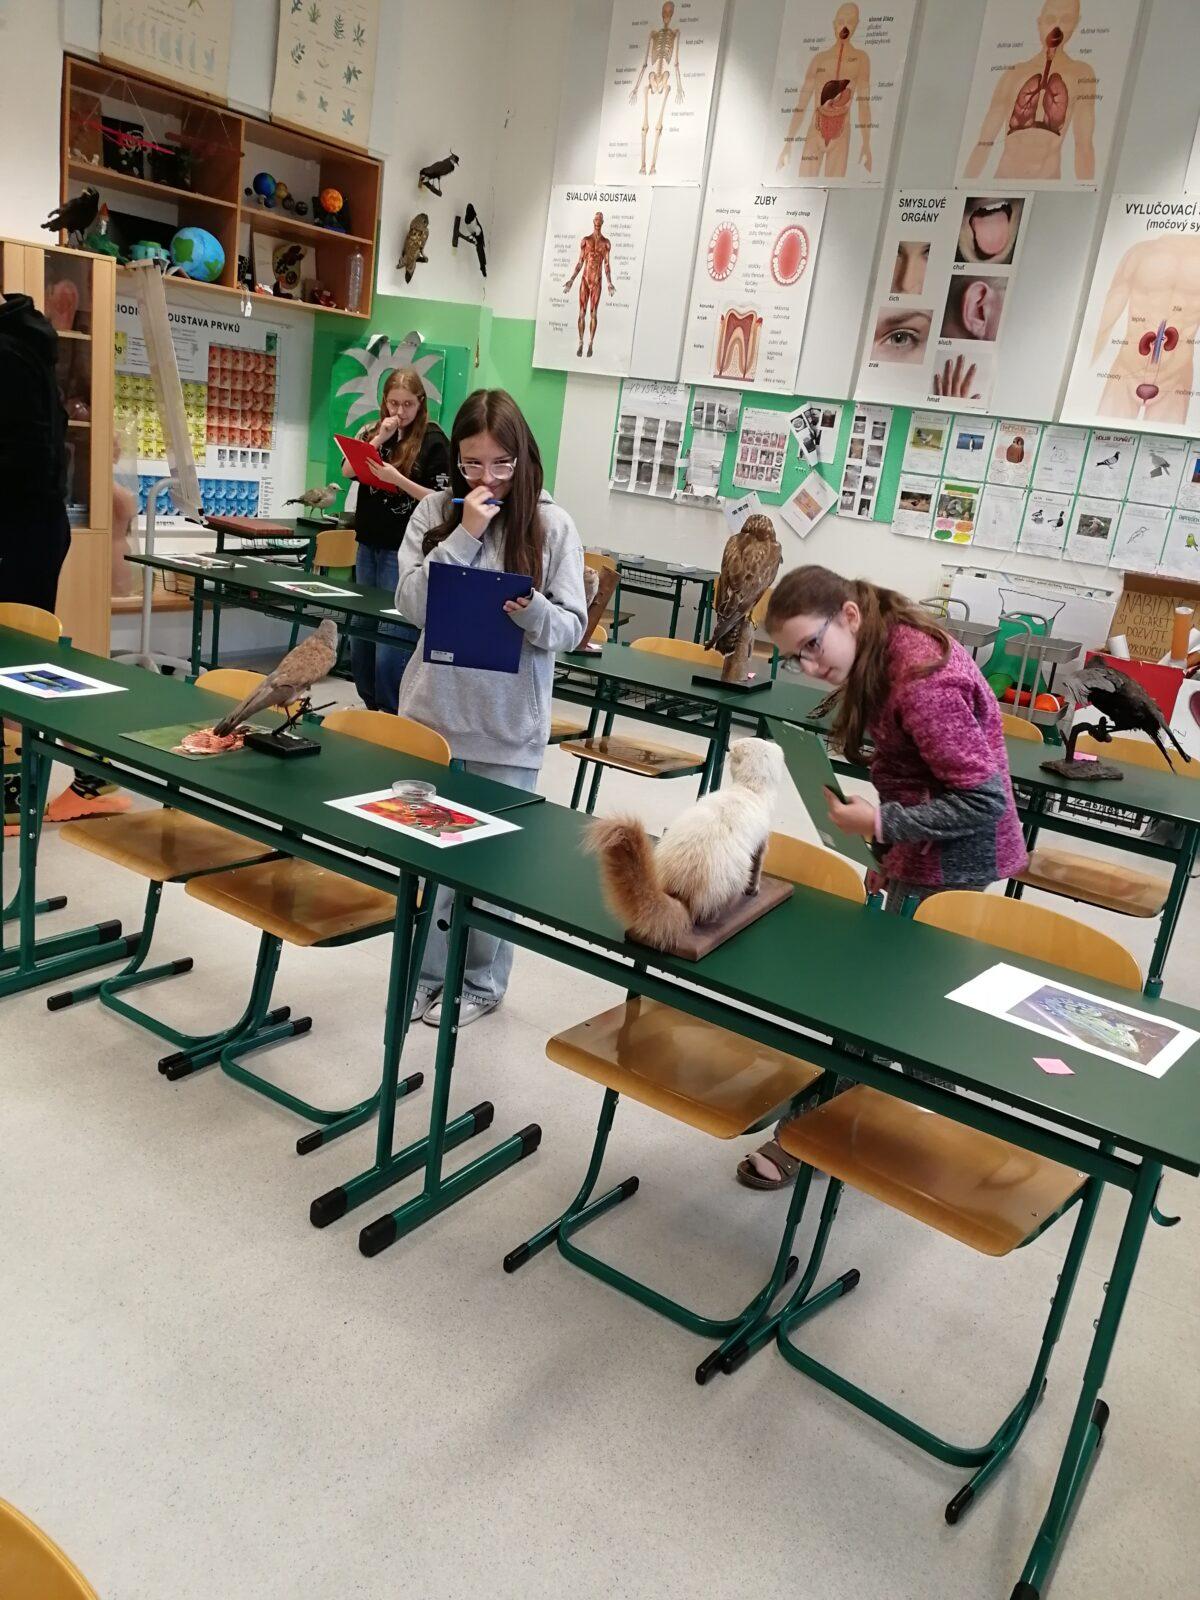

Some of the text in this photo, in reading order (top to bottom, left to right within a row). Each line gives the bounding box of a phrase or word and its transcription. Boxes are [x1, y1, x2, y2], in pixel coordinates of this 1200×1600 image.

[566, 190, 637, 202] SVALOVÁ SOUSTAVA
[754, 195, 777, 206] ZUBY
[898, 196, 947, 209] SMYSLOVÉ
[1125, 201, 1198, 216] VYLUČOVACÍ
[900, 210, 940, 223] ORGÁNY
[1146, 218, 1188, 232] (močový
[167, 312, 241, 334] OUSTAVA PRVKŮ
